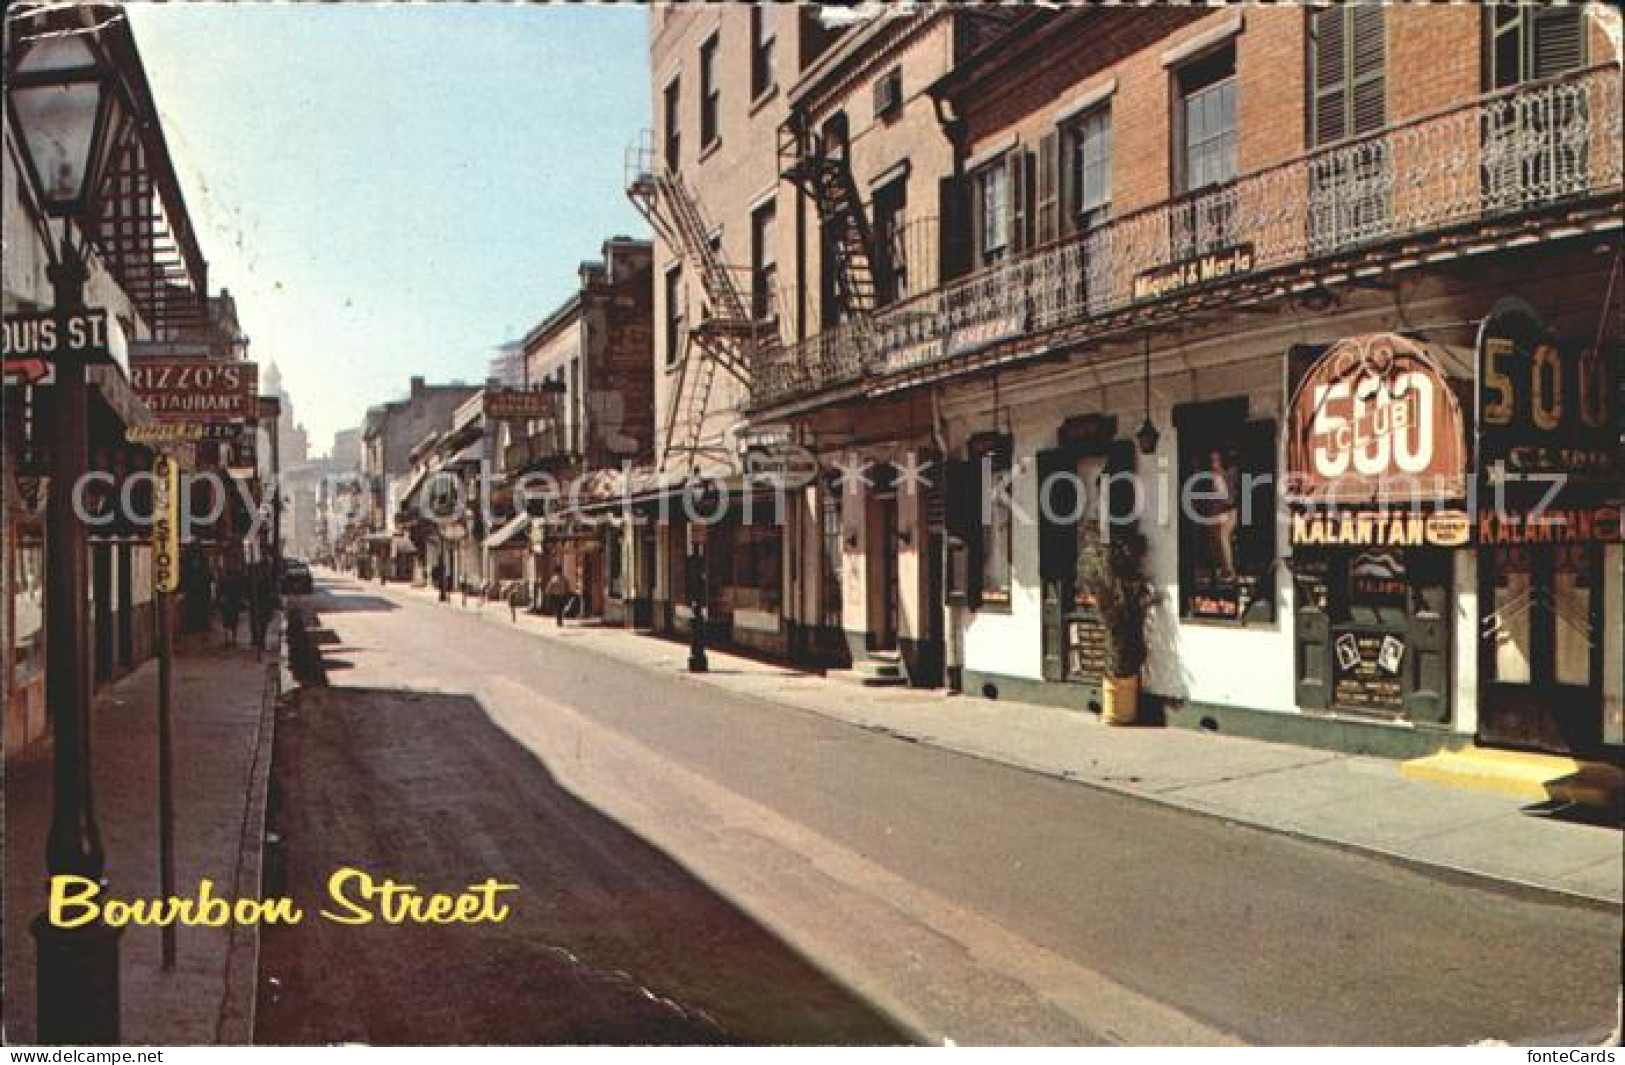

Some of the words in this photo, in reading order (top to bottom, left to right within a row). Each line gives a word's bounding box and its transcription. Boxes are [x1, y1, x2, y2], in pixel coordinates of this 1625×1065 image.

[69, 316, 103, 349] ST
[1485, 338, 1607, 430] 500
[1313, 372, 1433, 478] 500
[1335, 402, 1409, 450] CLUB
[1292, 512, 1424, 546] KALANTAN
[1480, 510, 1594, 543] KALANTAN
[157, 519, 170, 583] STOP
